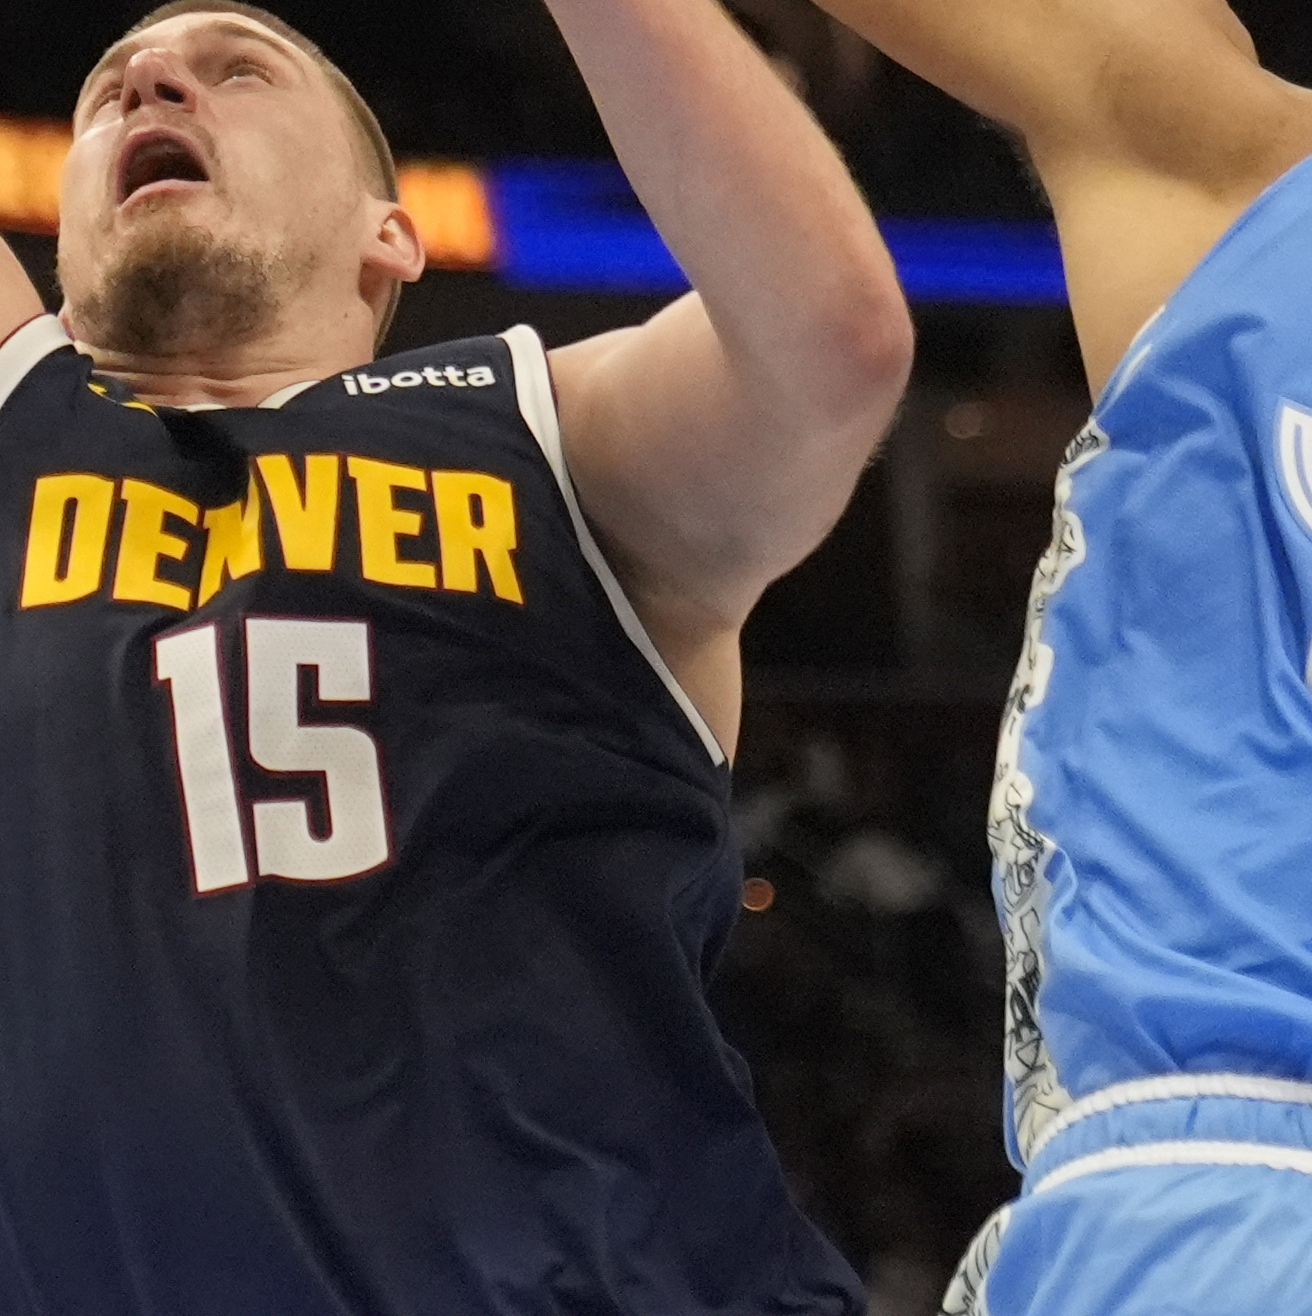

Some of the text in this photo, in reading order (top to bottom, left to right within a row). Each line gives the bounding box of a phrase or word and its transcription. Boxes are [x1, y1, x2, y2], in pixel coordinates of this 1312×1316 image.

[341, 366, 496, 396] ibotta
[19, 454, 524, 610] DENVER
[154, 615, 390, 893] 15
